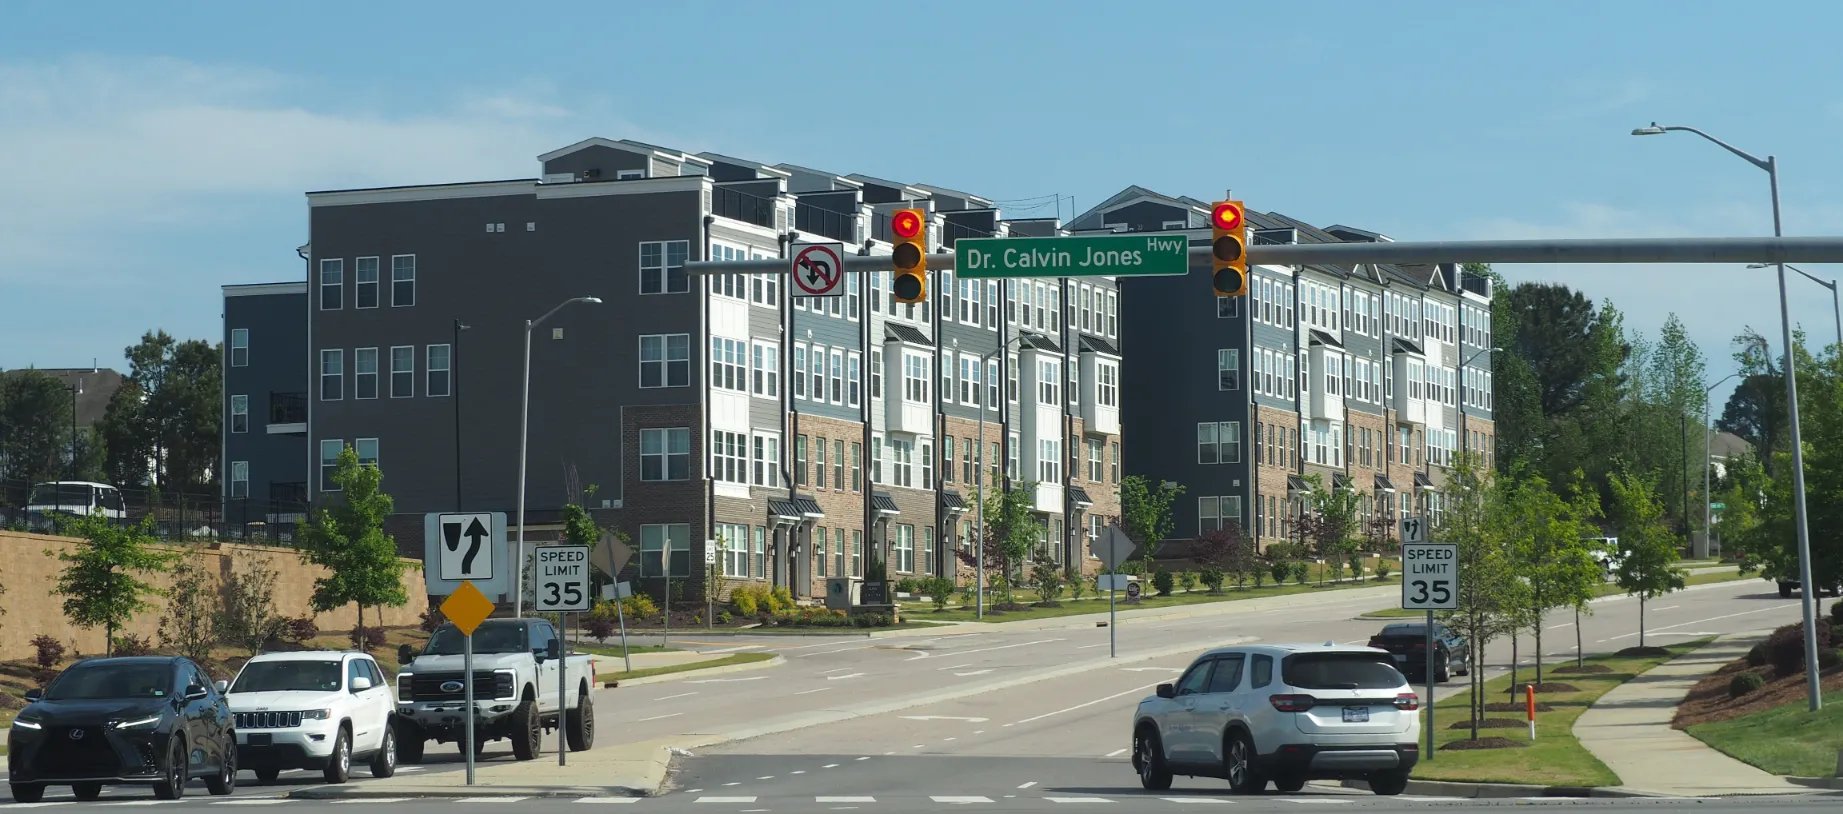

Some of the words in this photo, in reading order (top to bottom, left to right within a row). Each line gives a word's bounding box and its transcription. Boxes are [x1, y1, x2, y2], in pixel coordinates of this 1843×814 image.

[968, 249, 996, 269] Dr.
[1004, 247, 1071, 268] Calvin
[1079, 247, 1142, 267] Jones
[1147, 237, 1183, 255] Hwy
[540, 551, 585, 562] SPEED
[706, 552, 715, 561] 25
[1408, 549, 1453, 560] SPEED
[545, 565, 580, 576] LIMIT
[1413, 563, 1448, 574] LIMIT
[543, 582, 582, 605] 35
[1410, 580, 1451, 604] 35
